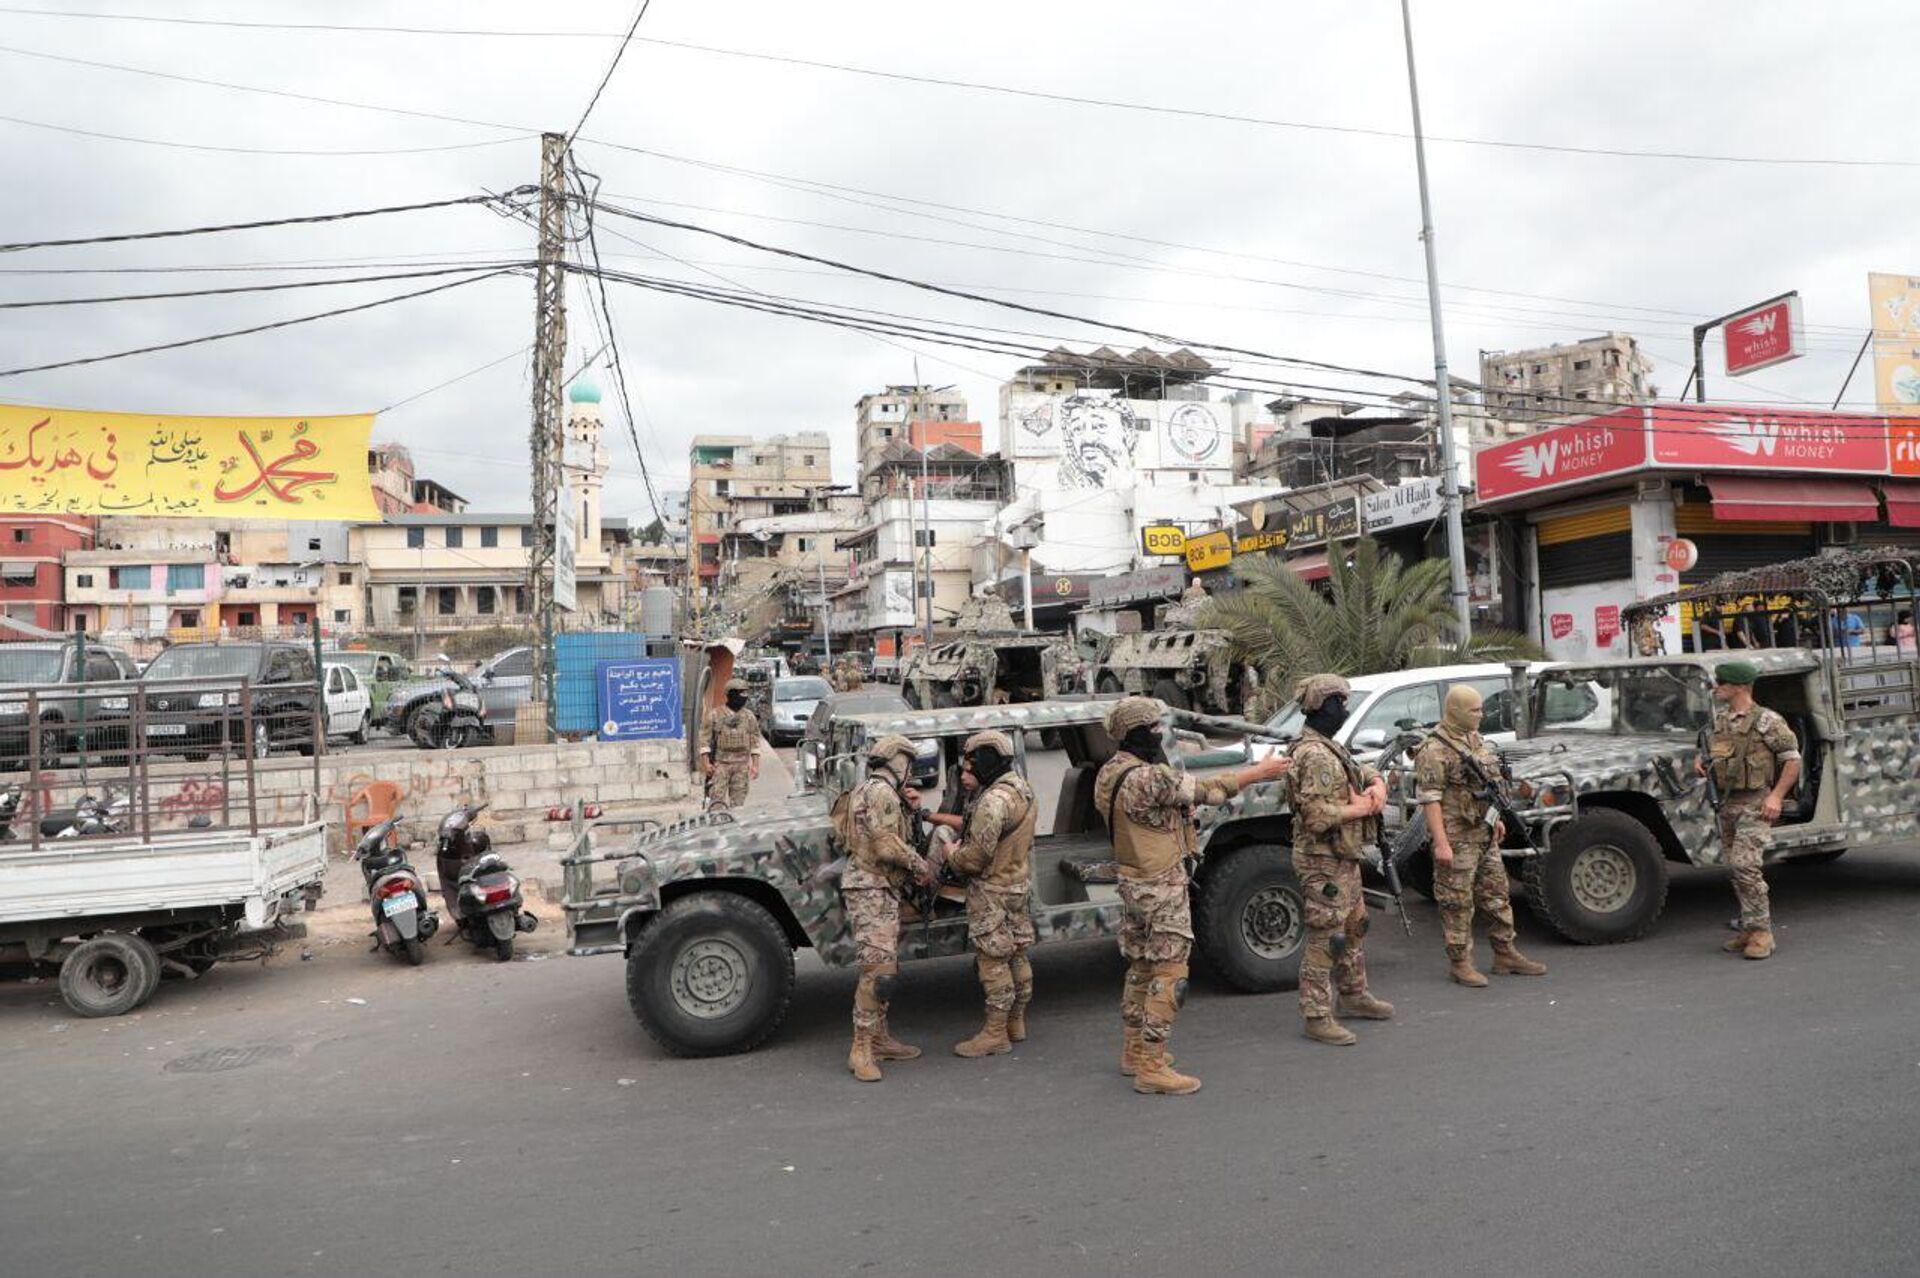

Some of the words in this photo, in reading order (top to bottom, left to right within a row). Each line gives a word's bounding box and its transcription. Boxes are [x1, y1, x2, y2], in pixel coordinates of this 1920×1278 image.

[1744, 334, 1777, 354] whish
[1559, 428, 1614, 457] whish
[1782, 422, 1846, 444] whish
[1784, 445, 1835, 459] MONEY
[1896, 430, 1920, 461] ri
[87, 426, 119, 489] في
[1561, 452, 1604, 471] MONEY
[1149, 534, 1182, 547] BOB
